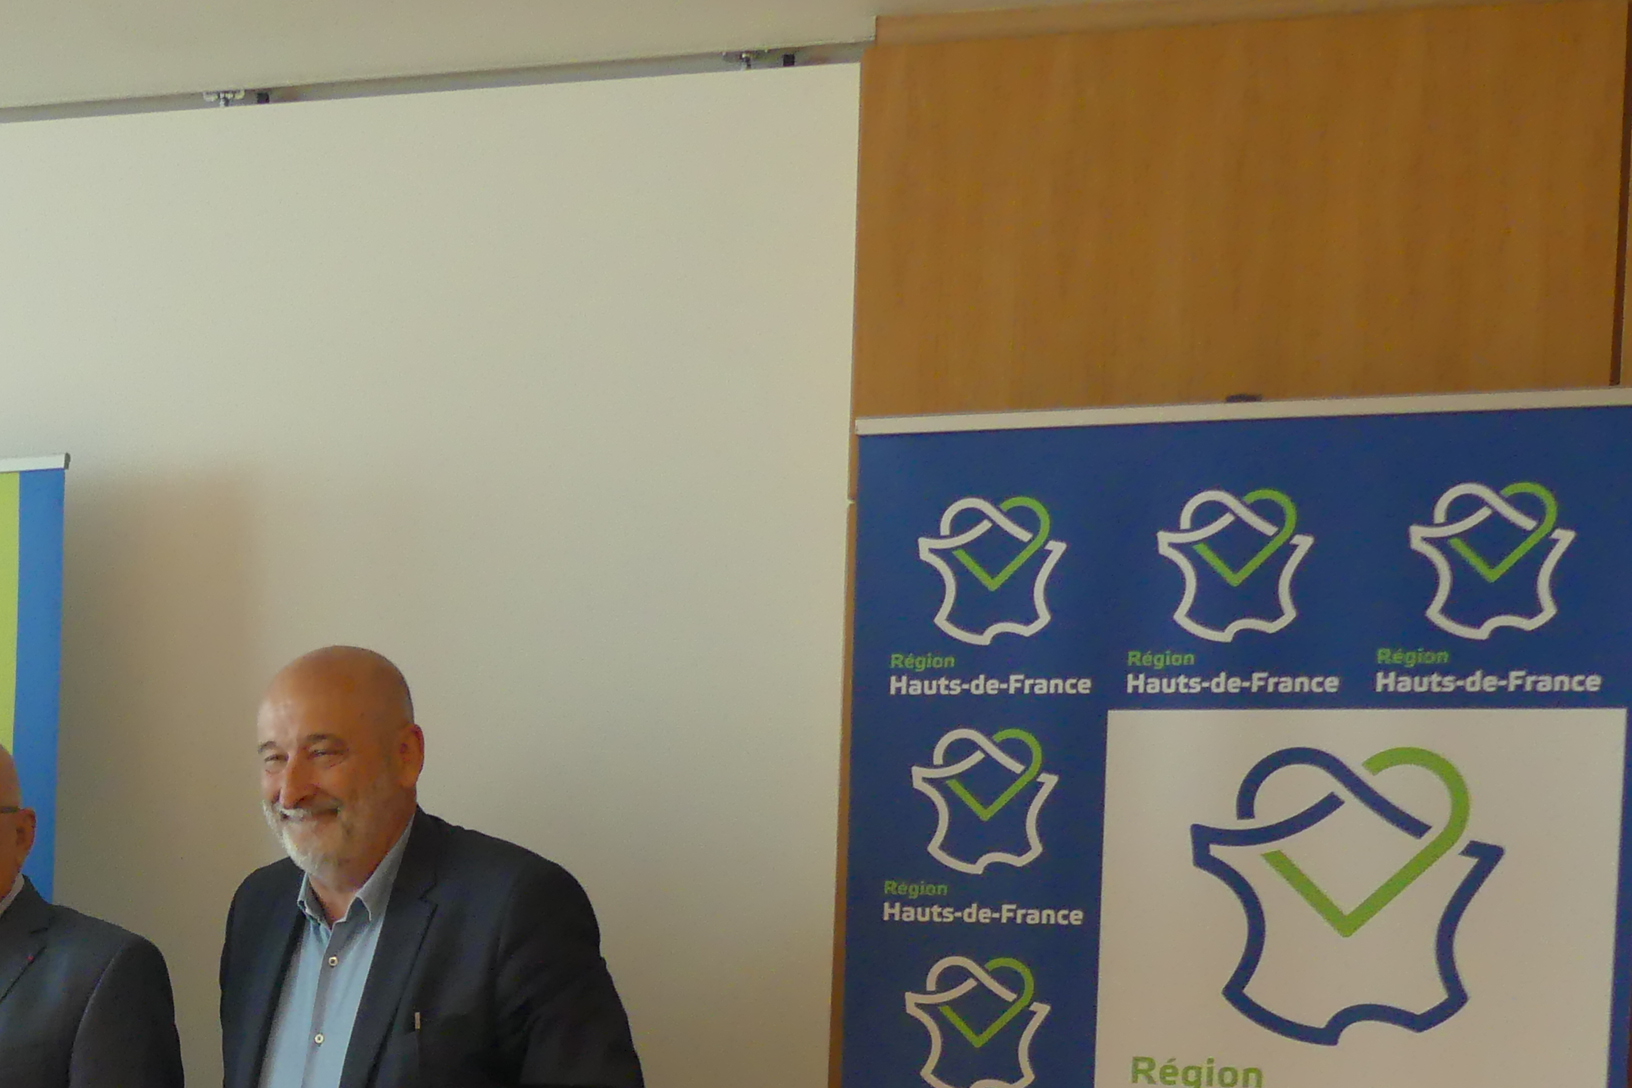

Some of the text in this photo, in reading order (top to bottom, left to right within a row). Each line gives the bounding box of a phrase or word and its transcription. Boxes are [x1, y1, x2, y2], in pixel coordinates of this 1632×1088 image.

[891, 653, 955, 671] Région
[1128, 650, 1195, 669] Région
[1377, 648, 1449, 667] Région
[890, 675, 1091, 694] Hauts-de-France
[1127, 672, 1339, 693] Hauts-de-France
[1376, 671, 1601, 692] Hauts-de-France
[885, 881, 947, 899] Région
[884, 903, 1083, 924] Hauts-de-France
